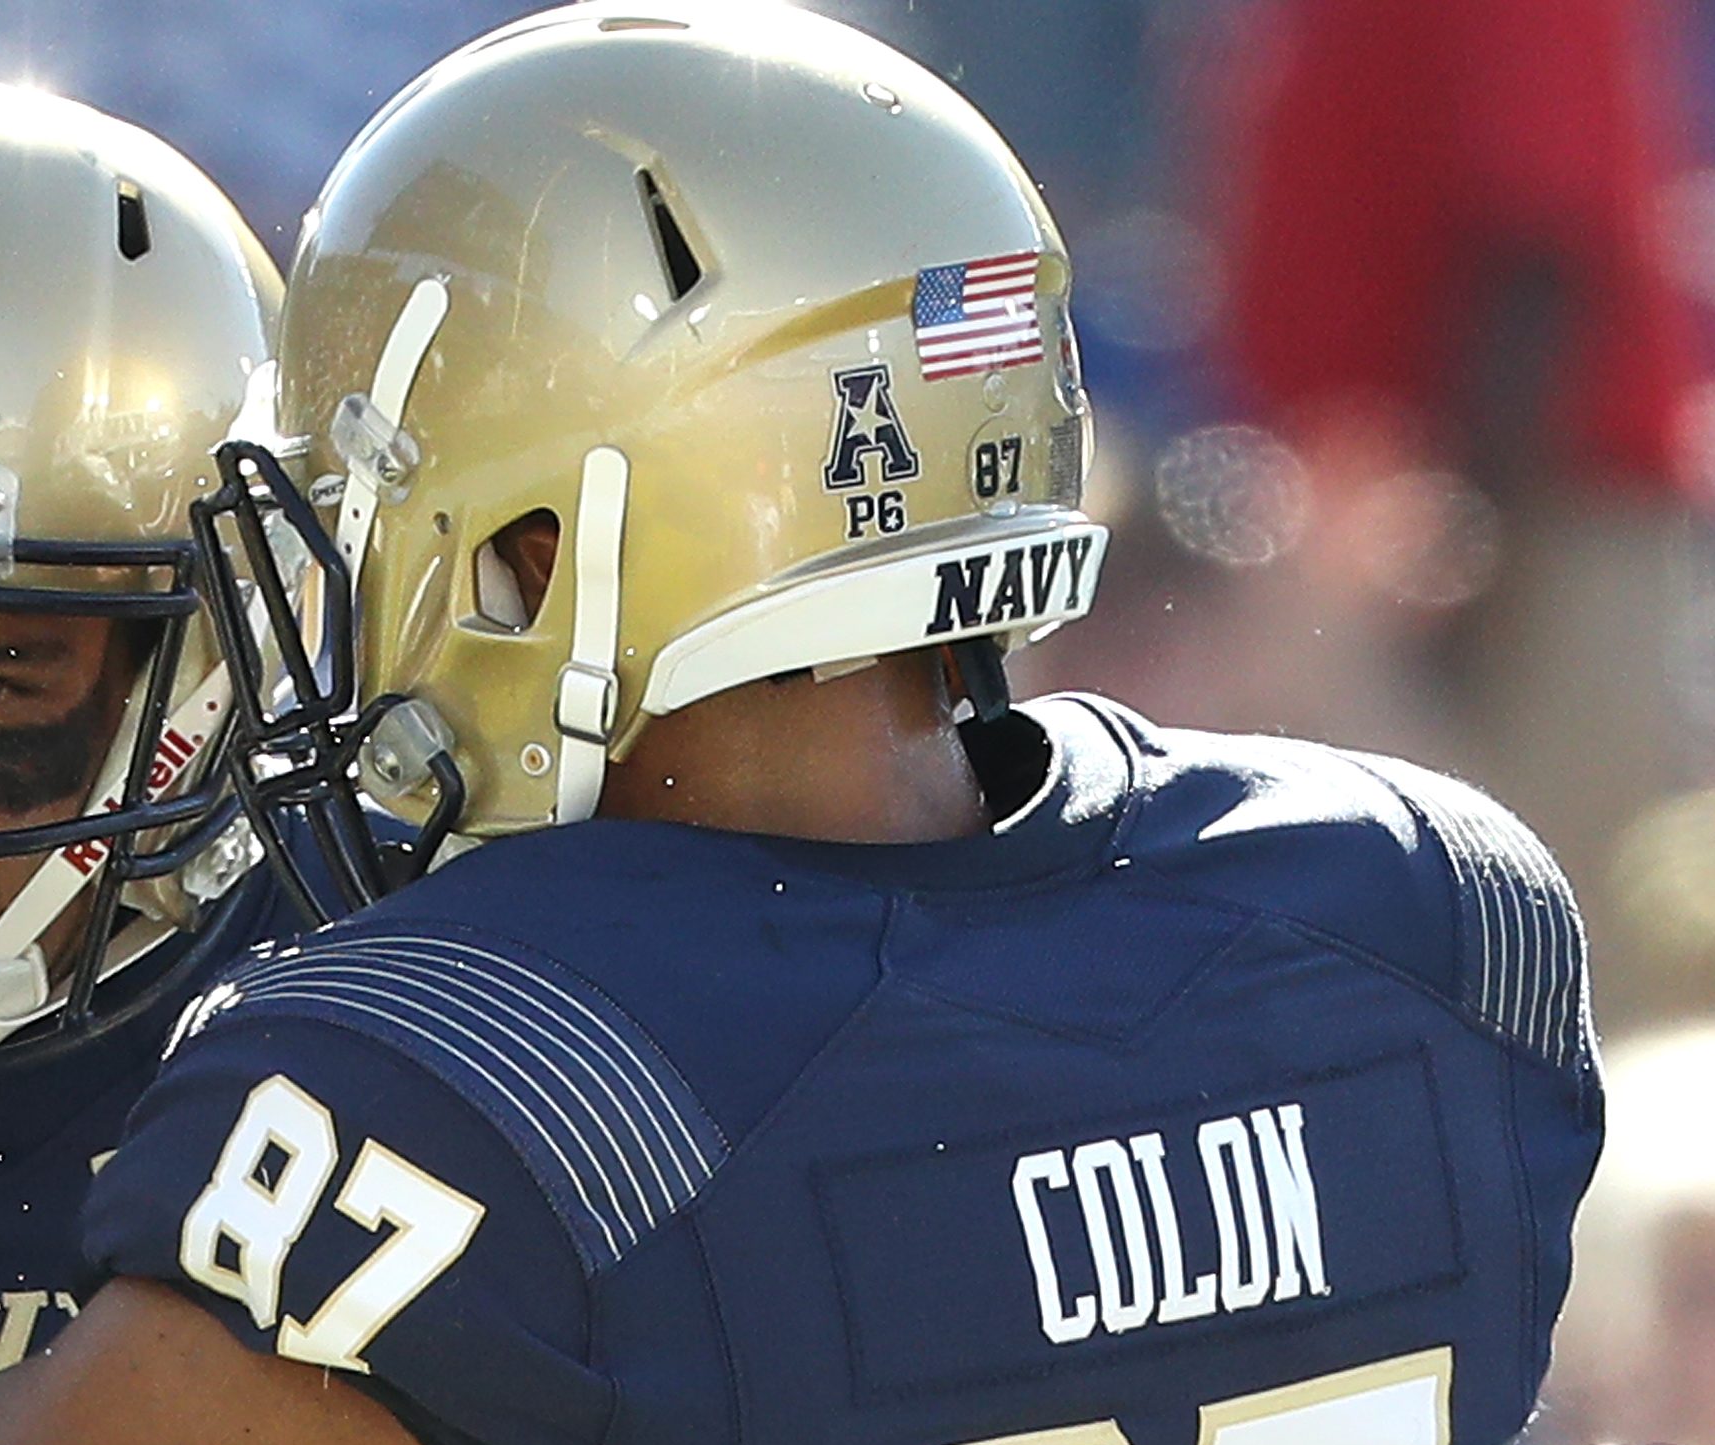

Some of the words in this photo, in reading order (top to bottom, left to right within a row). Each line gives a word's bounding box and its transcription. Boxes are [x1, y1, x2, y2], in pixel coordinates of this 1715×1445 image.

[846, 490, 905, 541] P6
[974, 437, 1023, 498] 87
[925, 536, 1093, 636] NAVY
[178, 1073, 487, 1375] 87
[1012, 1103, 1333, 1344] COLON
